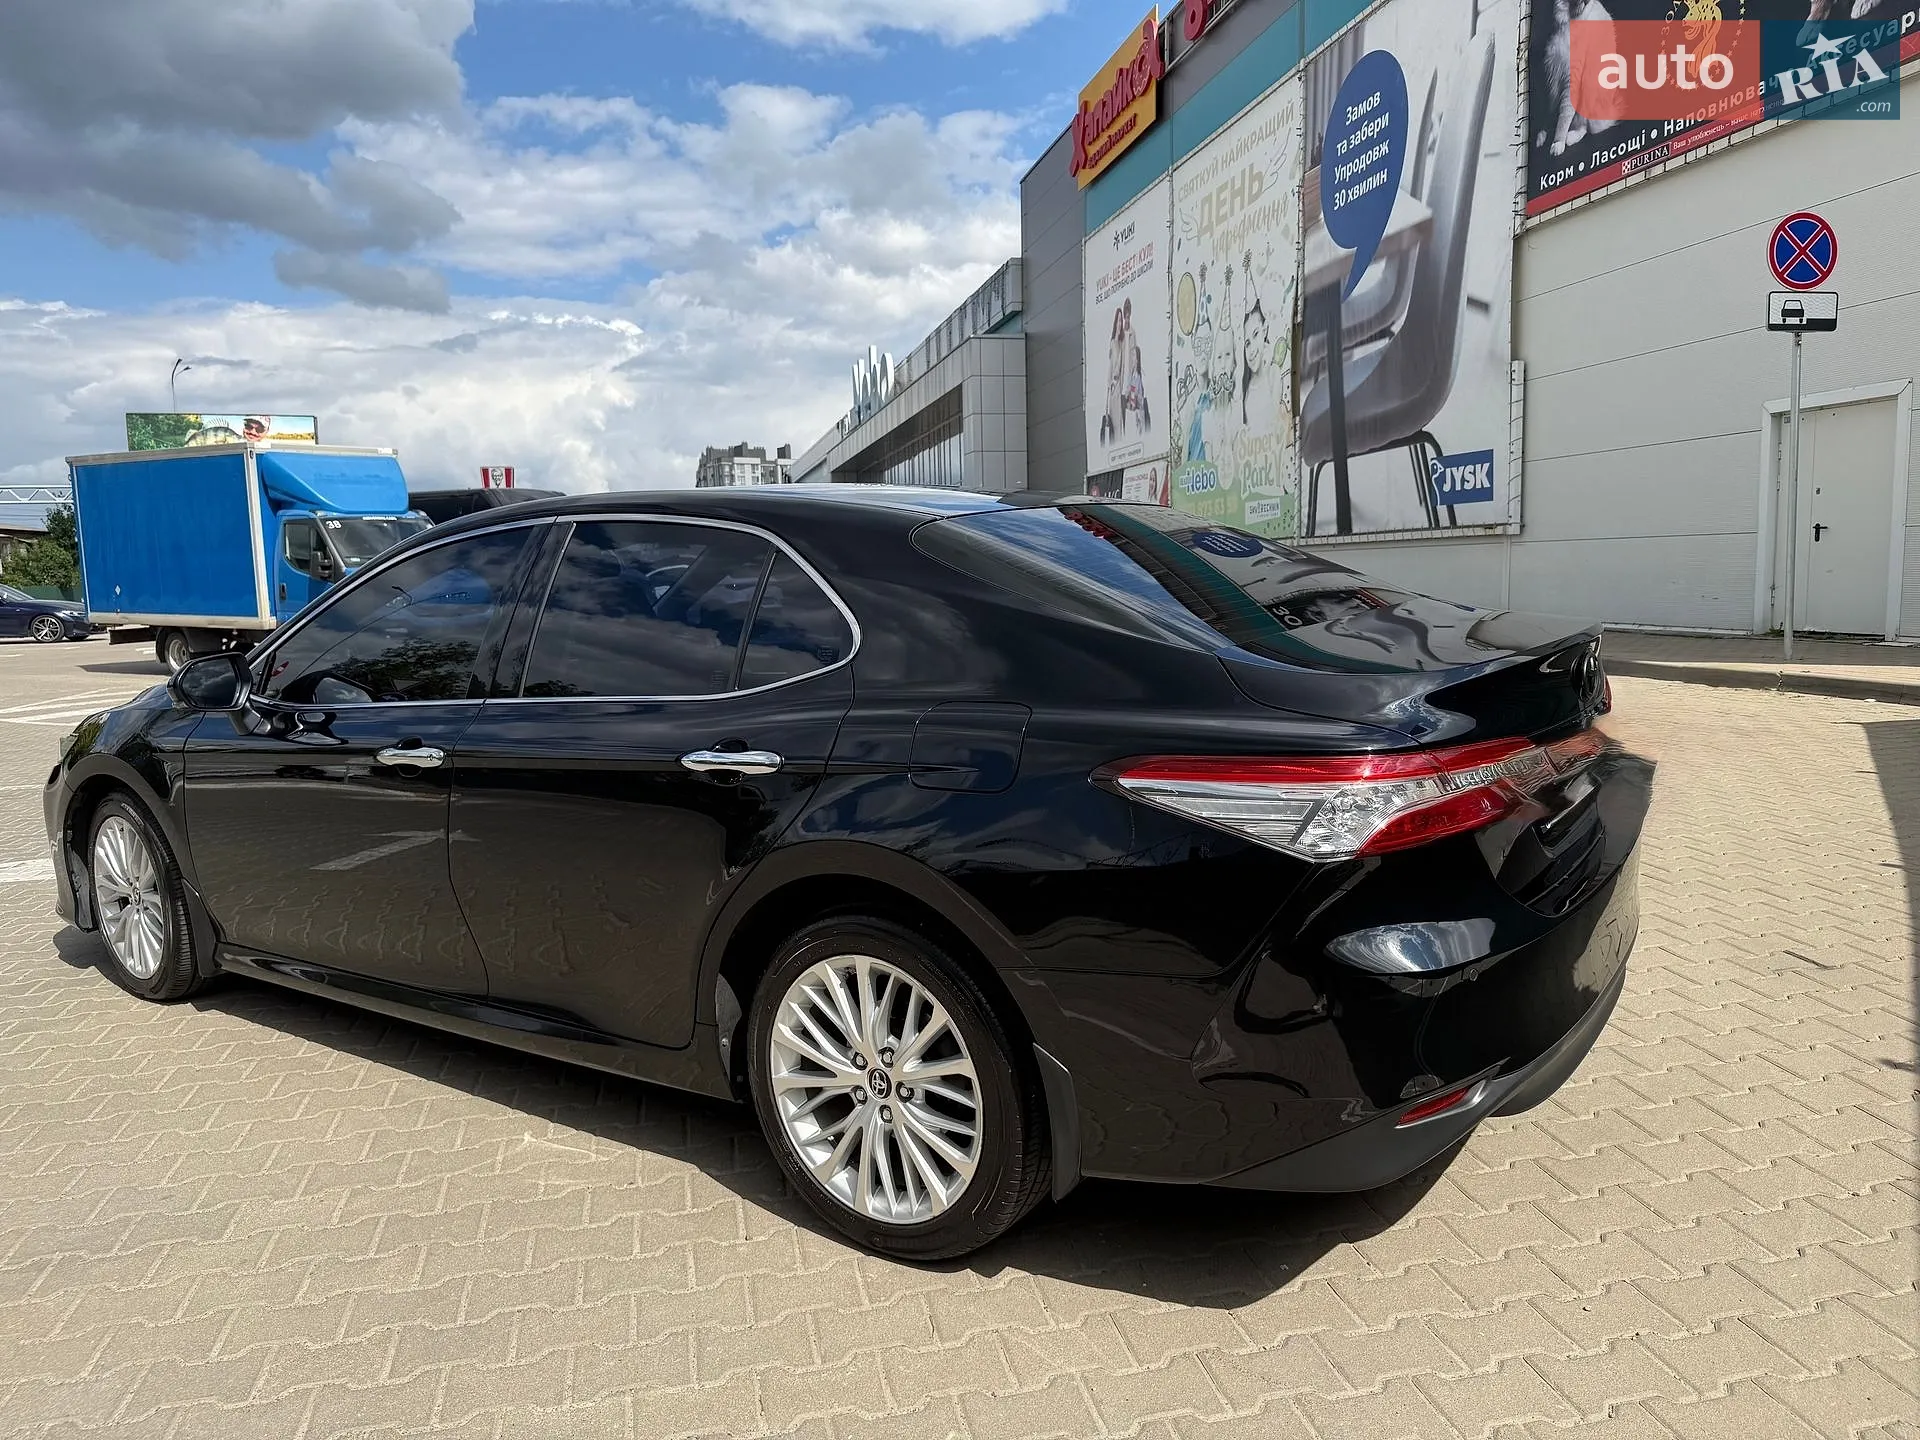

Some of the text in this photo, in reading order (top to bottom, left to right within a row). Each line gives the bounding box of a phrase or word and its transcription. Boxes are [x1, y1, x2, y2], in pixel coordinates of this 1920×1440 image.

[1345, 91, 1381, 126] Замов
[1540, 165, 1574, 190] Корм
[1590, 131, 1646, 168] Ласощі
[1804, 8, 1920, 72] Аксесуар
[1178, 98, 1295, 203] СВЯТКУЙ НАЙКРАЩИЙ
[1336, 111, 1389, 157] та забери
[1334, 139, 1390, 185] Упродовж
[1631, 145, 1669, 169] PURINA
[1197, 162, 1265, 247] ДЕНЬ
[1333, 167, 1387, 210] 30 хвилин
[1120, 220, 1136, 243] YUKI
[1442, 462, 1491, 493] JYSK
